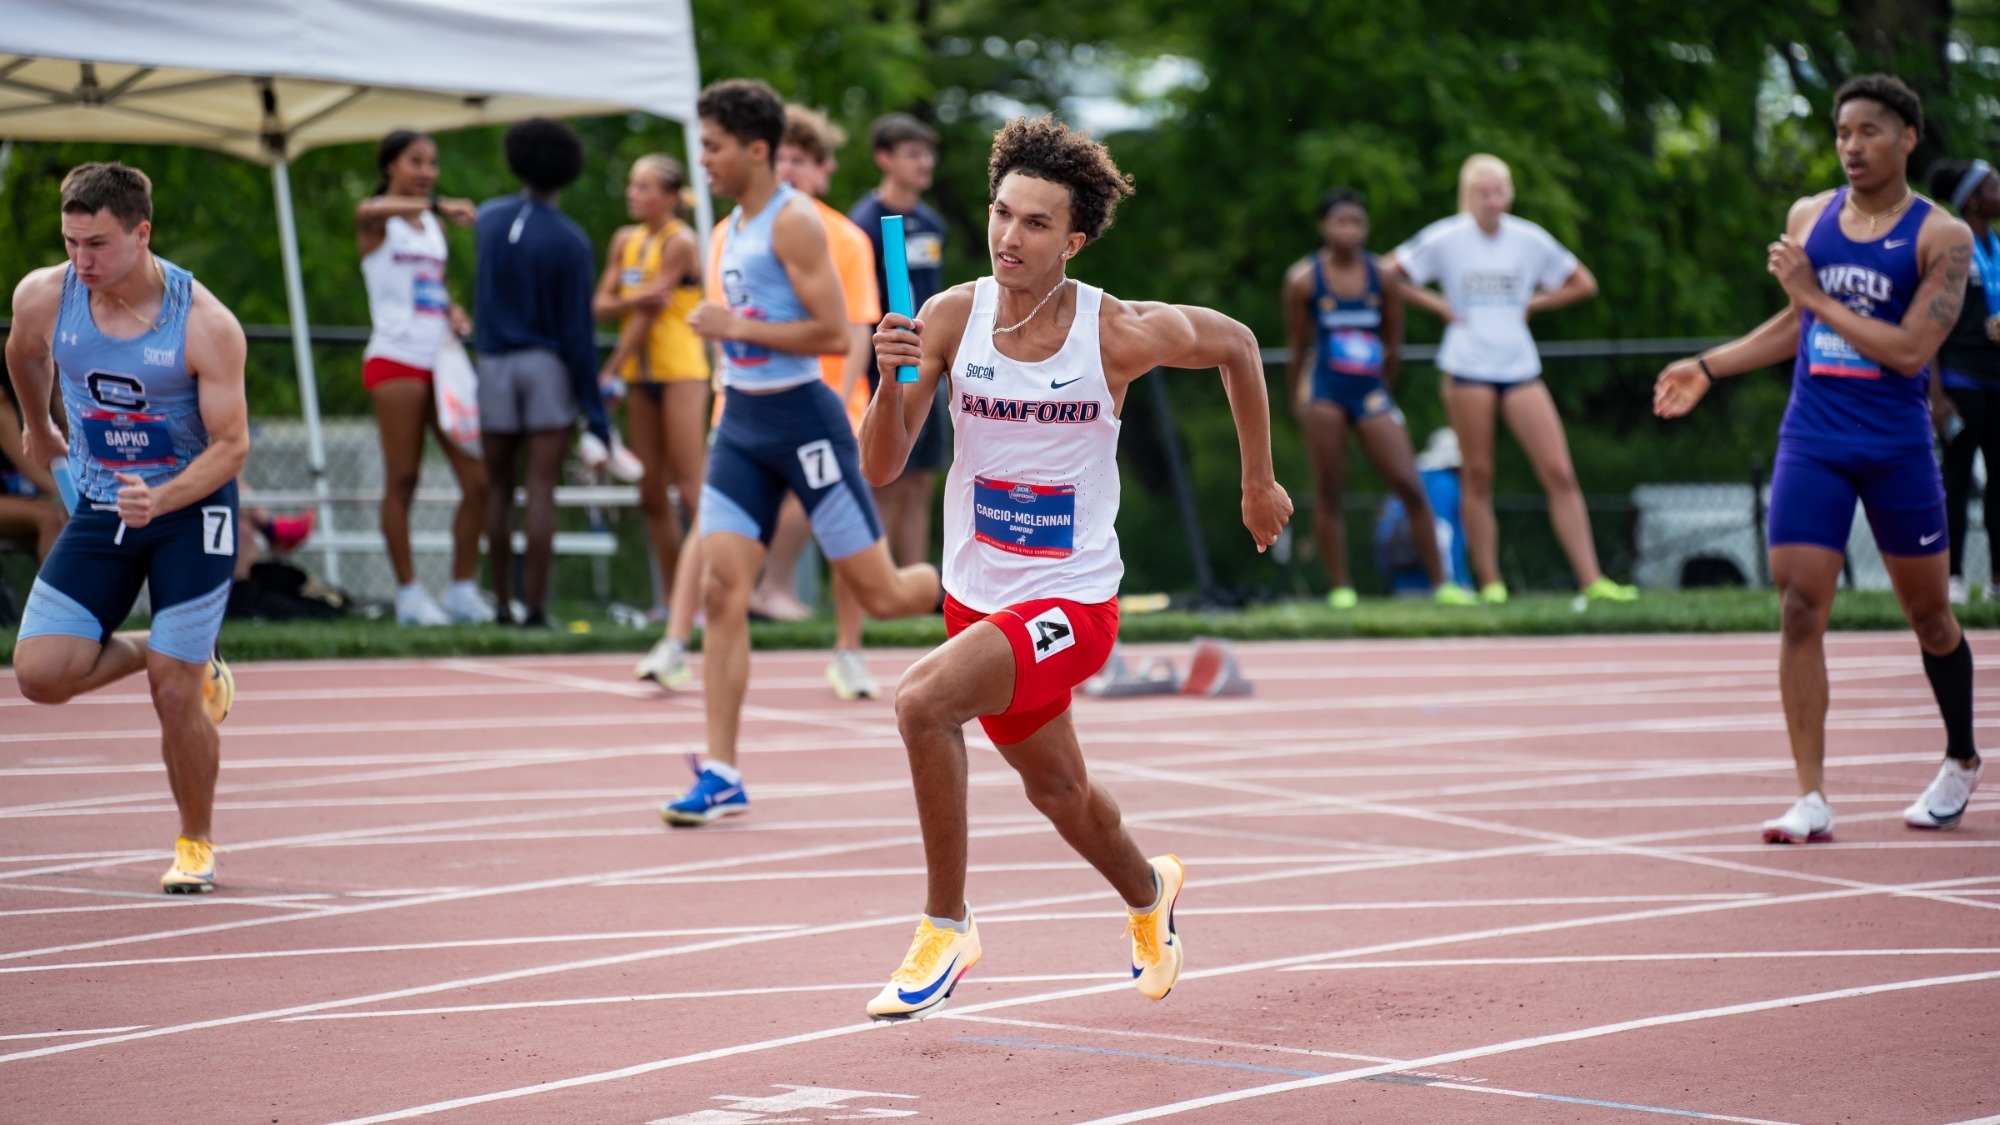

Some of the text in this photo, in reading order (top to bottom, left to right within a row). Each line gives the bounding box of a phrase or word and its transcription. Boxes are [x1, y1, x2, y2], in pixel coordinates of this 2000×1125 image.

[961, 392, 1101, 424] SAMFORD
[104, 430, 150, 447] SAPKO
[805, 448, 825, 481] 7
[207, 511, 227, 550] 7
[1010, 525, 1033, 534] SAMFORD
[1036, 621, 1070, 652] 4
